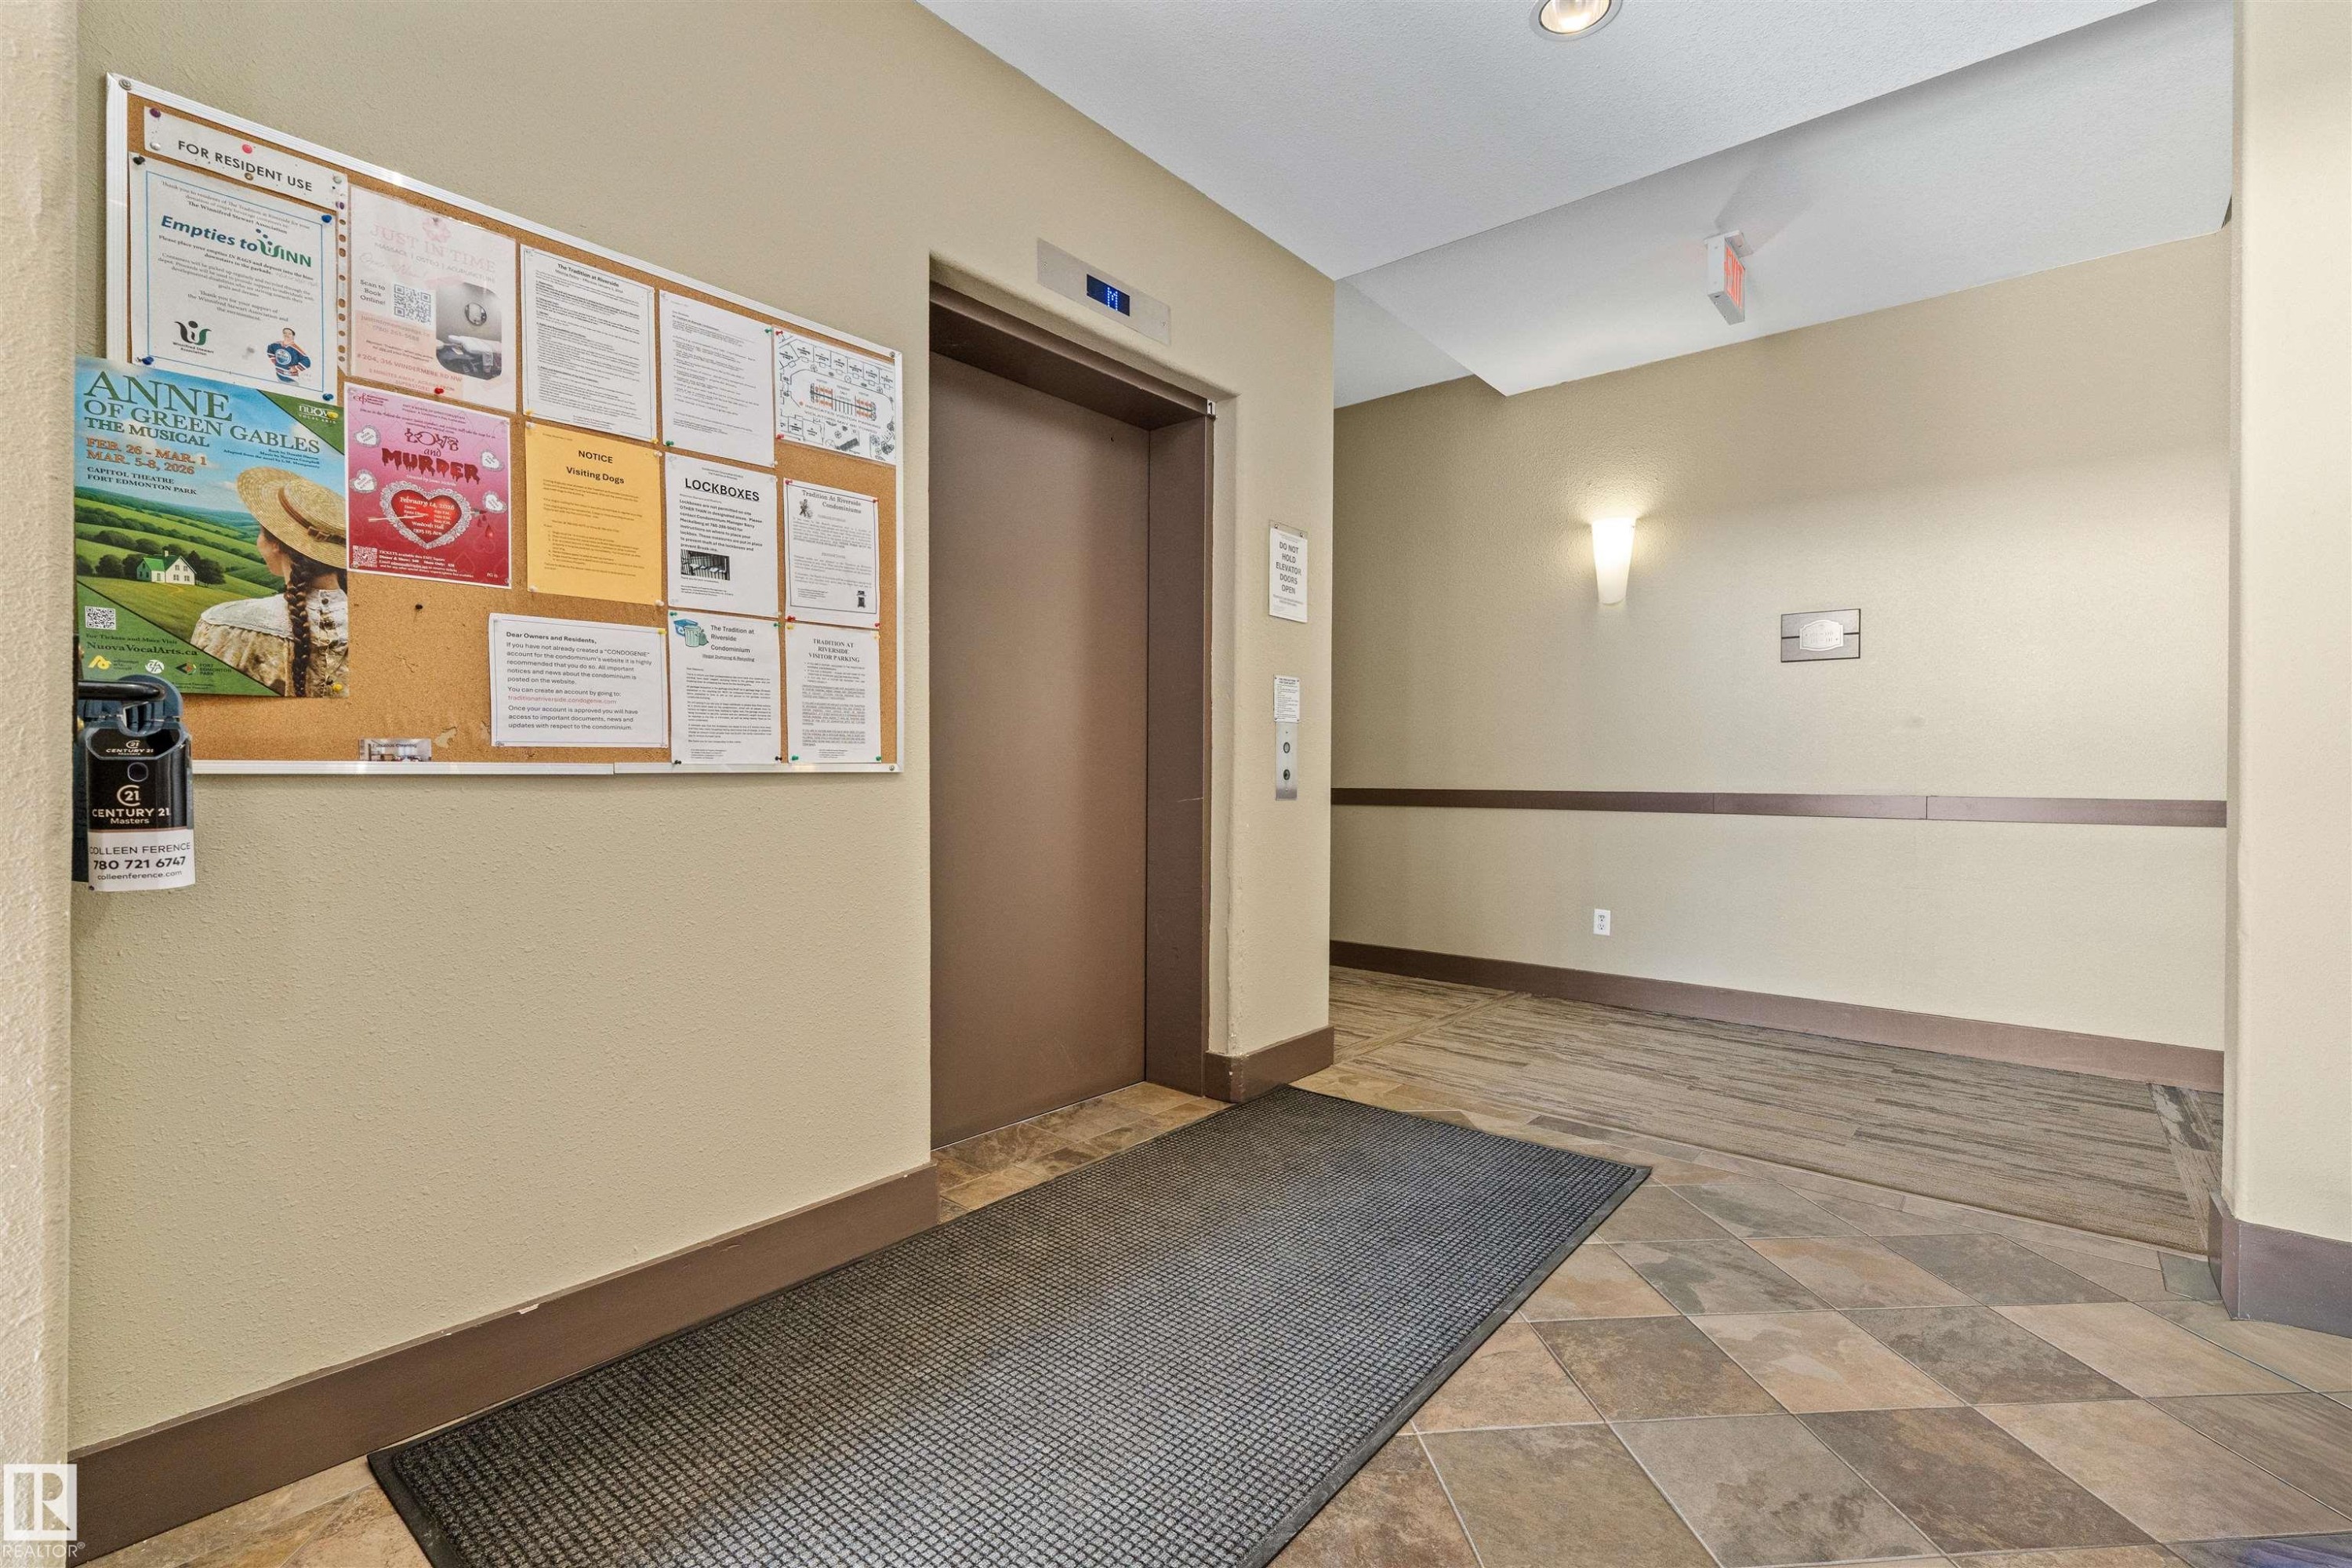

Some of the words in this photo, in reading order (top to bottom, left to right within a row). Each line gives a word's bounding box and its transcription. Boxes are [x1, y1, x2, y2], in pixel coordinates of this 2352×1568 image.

[178, 140, 209, 159] FOR
[215, 152, 282, 182] RESIDENT
[287, 176, 313, 191] USE
[161, 215, 235, 245] Empties
[240, 238, 257, 252] to
[370, 224, 418, 249] JUST
[424, 241, 445, 258] IN
[449, 249, 495, 273] TIME
[360, 278, 376, 289] Scan
[568, 267, 591, 279] Tradition
[597, 276, 619, 288] Riverside
[364, 287, 382, 297] Book
[1107, 287, 1118, 311] M
[360, 294, 386, 306] Online!
[83, 371, 232, 421] ANNE
[299, 404, 336, 419] nuov
[84, 399, 124, 418] OF
[130, 407, 223, 437] GREEN
[230, 425, 321, 454] GABLES
[84, 416, 125, 433] THE
[129, 424, 209, 448] MUSICAL
[404, 428, 459, 452] LOVE
[86, 437, 122, 452] FEB.
[125, 444, 143, 455] 26
[154, 448, 196, 464] MAR.
[200, 456, 207, 466] 1
[423, 448, 441, 457] and
[578, 450, 613, 464] NOTICE
[86, 449, 130, 465] MAR.
[134, 457, 161, 471] 5-8,
[164, 462, 195, 475] 2026
[381, 448, 481, 485] MURDER
[86, 466, 129, 478] CAPITOL
[131, 472, 175, 485] THEATRE
[566, 466, 601, 481] Visiting
[602, 474, 625, 485] Dogs
[87, 474, 113, 483] FORT
[115, 477, 172, 492] EDMONTON
[173, 486, 197, 495] PARK
[684, 477, 760, 502] LOCKBOXES
[399, 495, 428, 507] February
[801, 489, 829, 501] Tradition
[837, 497, 861, 506] Riverside
[822, 502, 862, 514] Condominiums
[1279, 542, 1287, 550] DO
[1288, 545, 1298, 554] NOT
[1282, 553, 1296, 564] HOLD
[1276, 561, 1301, 575] ELEVATOR
[1279, 573, 1298, 585] DOORS
[1281, 584, 1296, 594] OPEN
[723, 626, 747, 634] Tradition
[86, 641, 198, 656] NuovaVocalArts.ca
[710, 644, 750, 653] Condominium
[812, 638, 844, 647] TRADITION
[92, 808, 154, 818] CENTURY
[158, 807, 171, 817] 21
[110, 816, 150, 825] Masters
[89, 845, 138, 855] COLLEEN
[142, 842, 191, 855] FERENCE
[93, 860, 119, 870] 780
[124, 859, 150, 869] 721
[155, 856, 186, 869] 6747
[97, 869, 183, 881] colleenference.com
